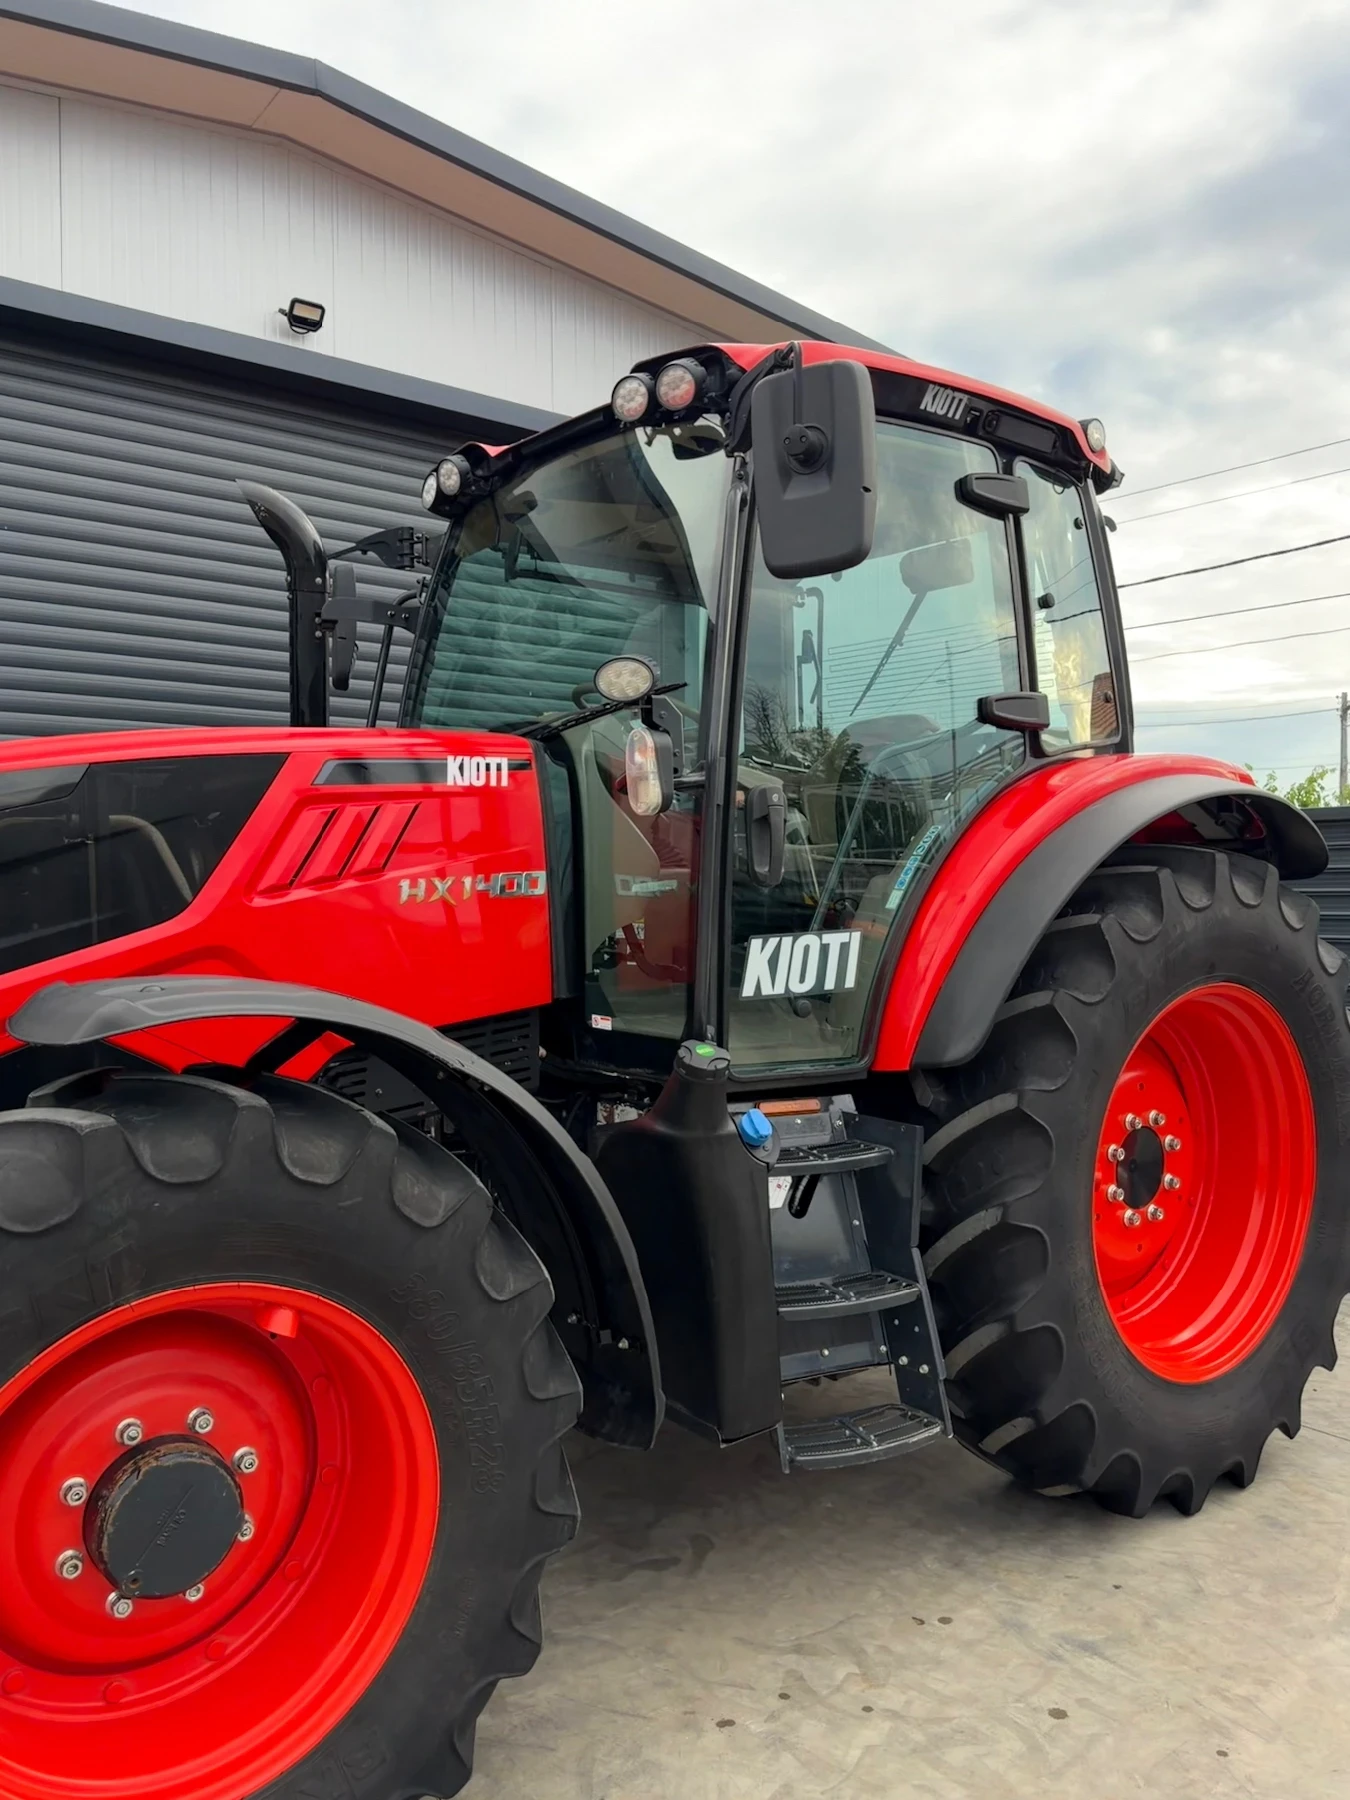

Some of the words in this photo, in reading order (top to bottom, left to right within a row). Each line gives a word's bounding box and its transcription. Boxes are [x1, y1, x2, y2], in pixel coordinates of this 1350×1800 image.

[920, 383, 967, 420] KIOTI
[447, 756, 509, 787] KIOTI
[399, 871, 546, 906] HX1400
[741, 931, 862, 998] KIOTI
